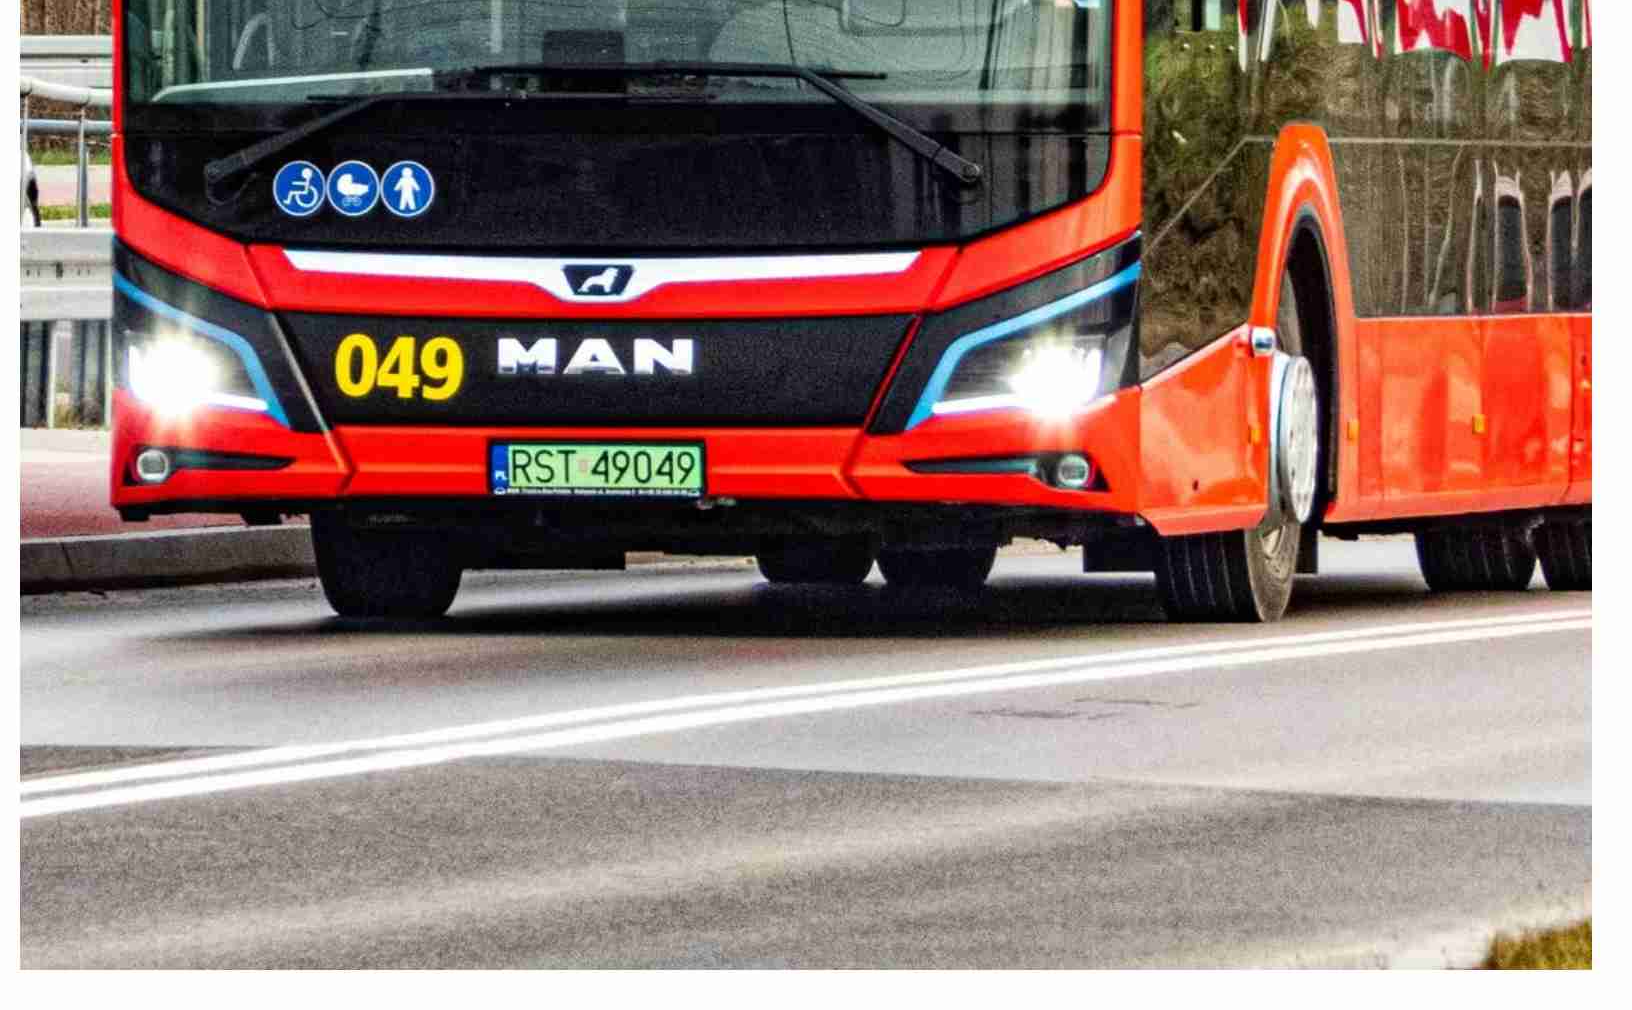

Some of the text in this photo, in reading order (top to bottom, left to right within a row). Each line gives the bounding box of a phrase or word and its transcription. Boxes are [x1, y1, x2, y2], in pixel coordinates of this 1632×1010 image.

[334, 333, 465, 400] 049
[497, 337, 695, 375] MAN
[511, 449, 696, 485] RST 49049
